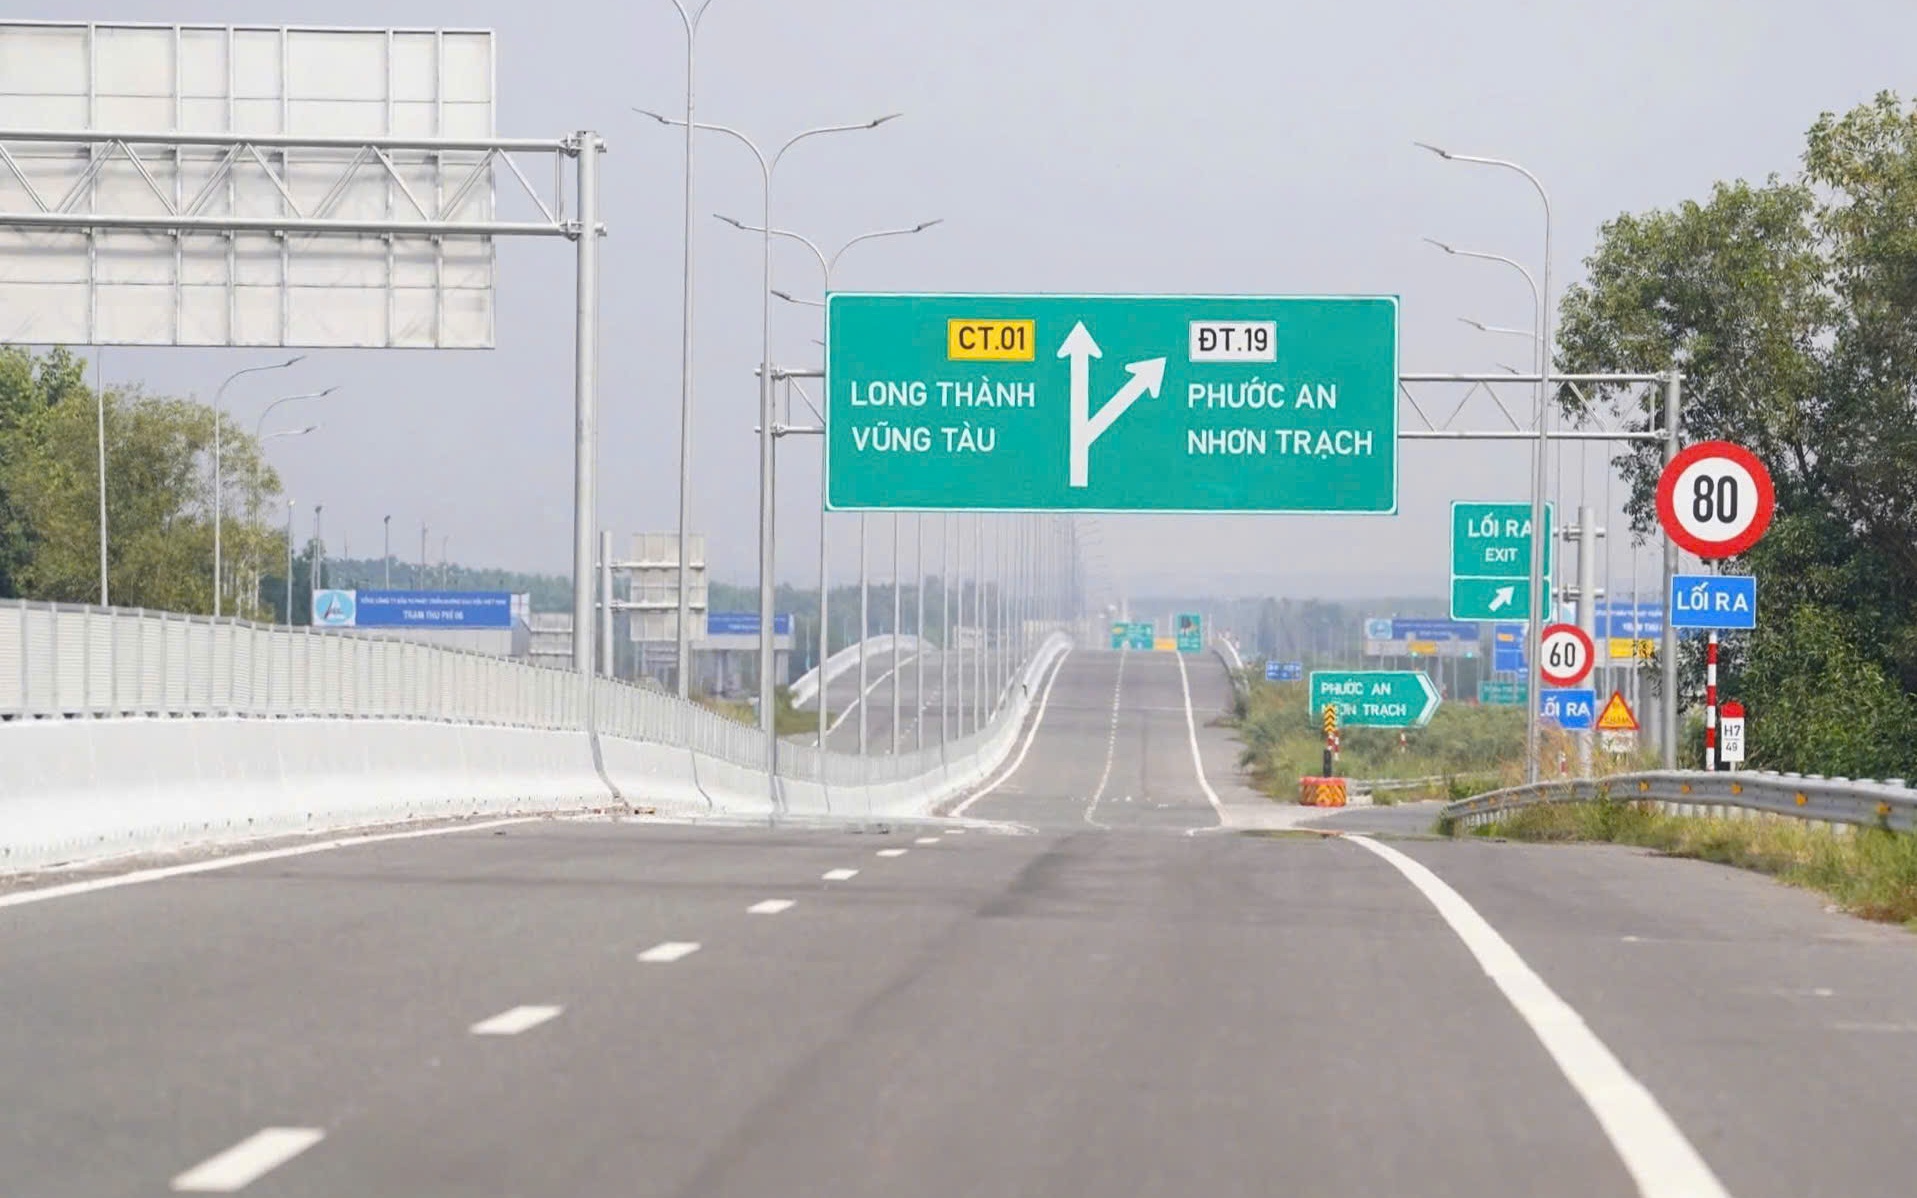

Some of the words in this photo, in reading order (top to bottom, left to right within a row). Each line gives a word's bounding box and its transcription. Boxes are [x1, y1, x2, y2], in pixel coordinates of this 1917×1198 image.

[958, 324, 1026, 352] CT.01
[1198, 326, 1269, 353] ĐT.19
[850, 381, 928, 407] LONG
[937, 374, 1036, 408] THÀNH
[1188, 376, 1285, 409] PHƯỚC
[1295, 384, 1337, 409] AN
[852, 419, 932, 454] VŨNG
[941, 419, 996, 453] TÀU
[1188, 427, 1267, 455] NHƠN
[1275, 430, 1373, 460] TRẠCH
[1693, 474, 1738, 523] 80
[1468, 511, 1500, 538] LỐI
[1505, 519, 1532, 538] RA
[1485, 547, 1518, 562] EXIT
[1677, 581, 1709, 611] LỐI
[1715, 593, 1749, 612] RA
[1550, 642, 1575, 666] 60
[1371, 682, 1392, 695] AN
[1566, 702, 1590, 716] RA
[1724, 724, 1741, 737] H7
[1725, 741, 1738, 751] 49
